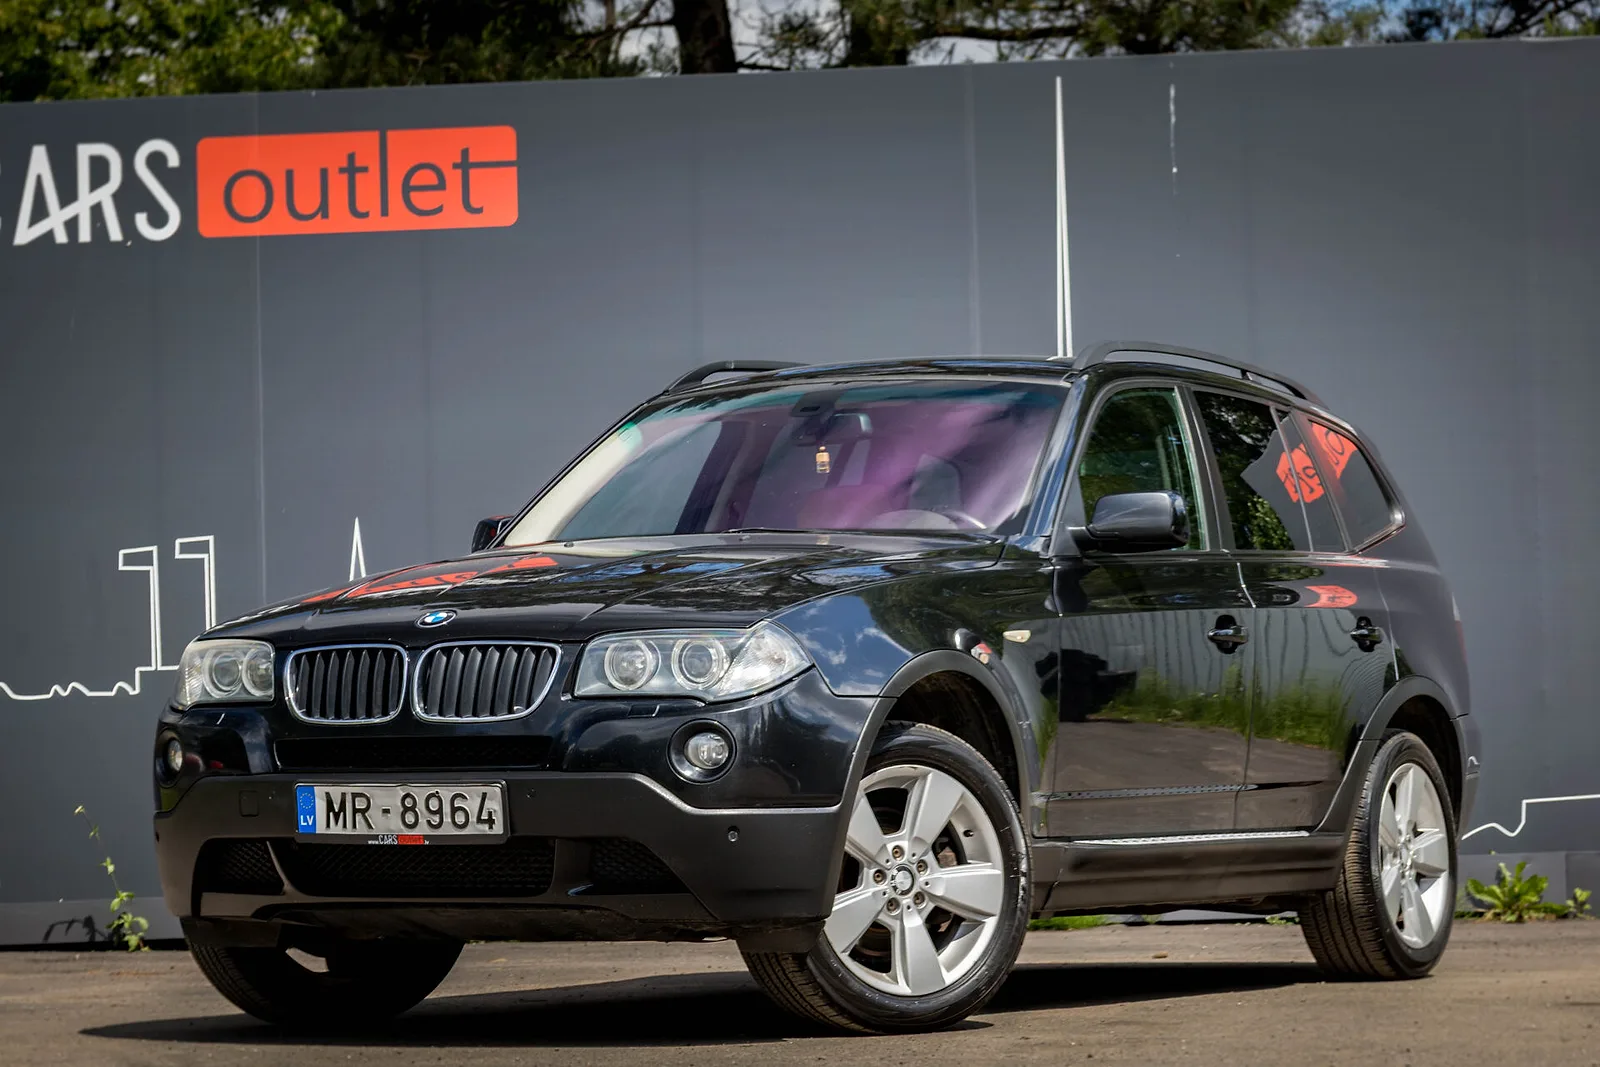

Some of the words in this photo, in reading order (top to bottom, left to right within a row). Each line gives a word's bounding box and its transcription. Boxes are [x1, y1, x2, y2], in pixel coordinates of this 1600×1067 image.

[0, 139, 181, 246] ARS
[222, 130, 518, 224] outlet
[300, 814, 314, 826] LV
[324, 791, 496, 831] MR-8964
